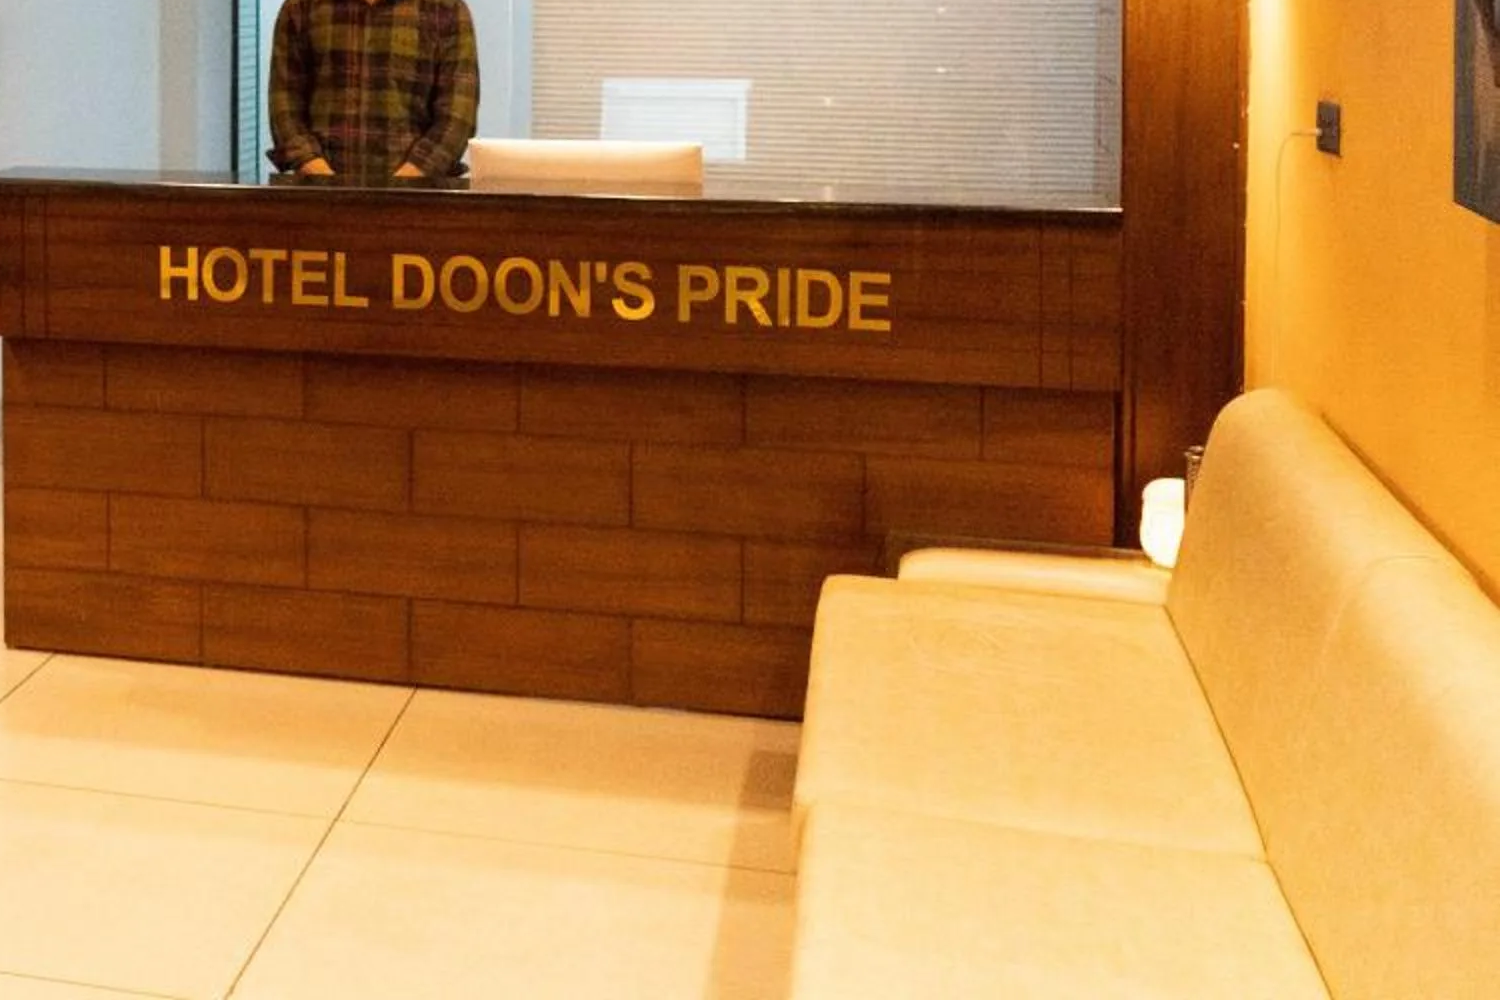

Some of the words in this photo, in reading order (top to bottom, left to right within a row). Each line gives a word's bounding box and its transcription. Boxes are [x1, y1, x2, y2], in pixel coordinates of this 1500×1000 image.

[160, 245, 368, 307] HOTEL
[391, 253, 654, 321] DOON'S
[677, 264, 891, 332] PRIDE
